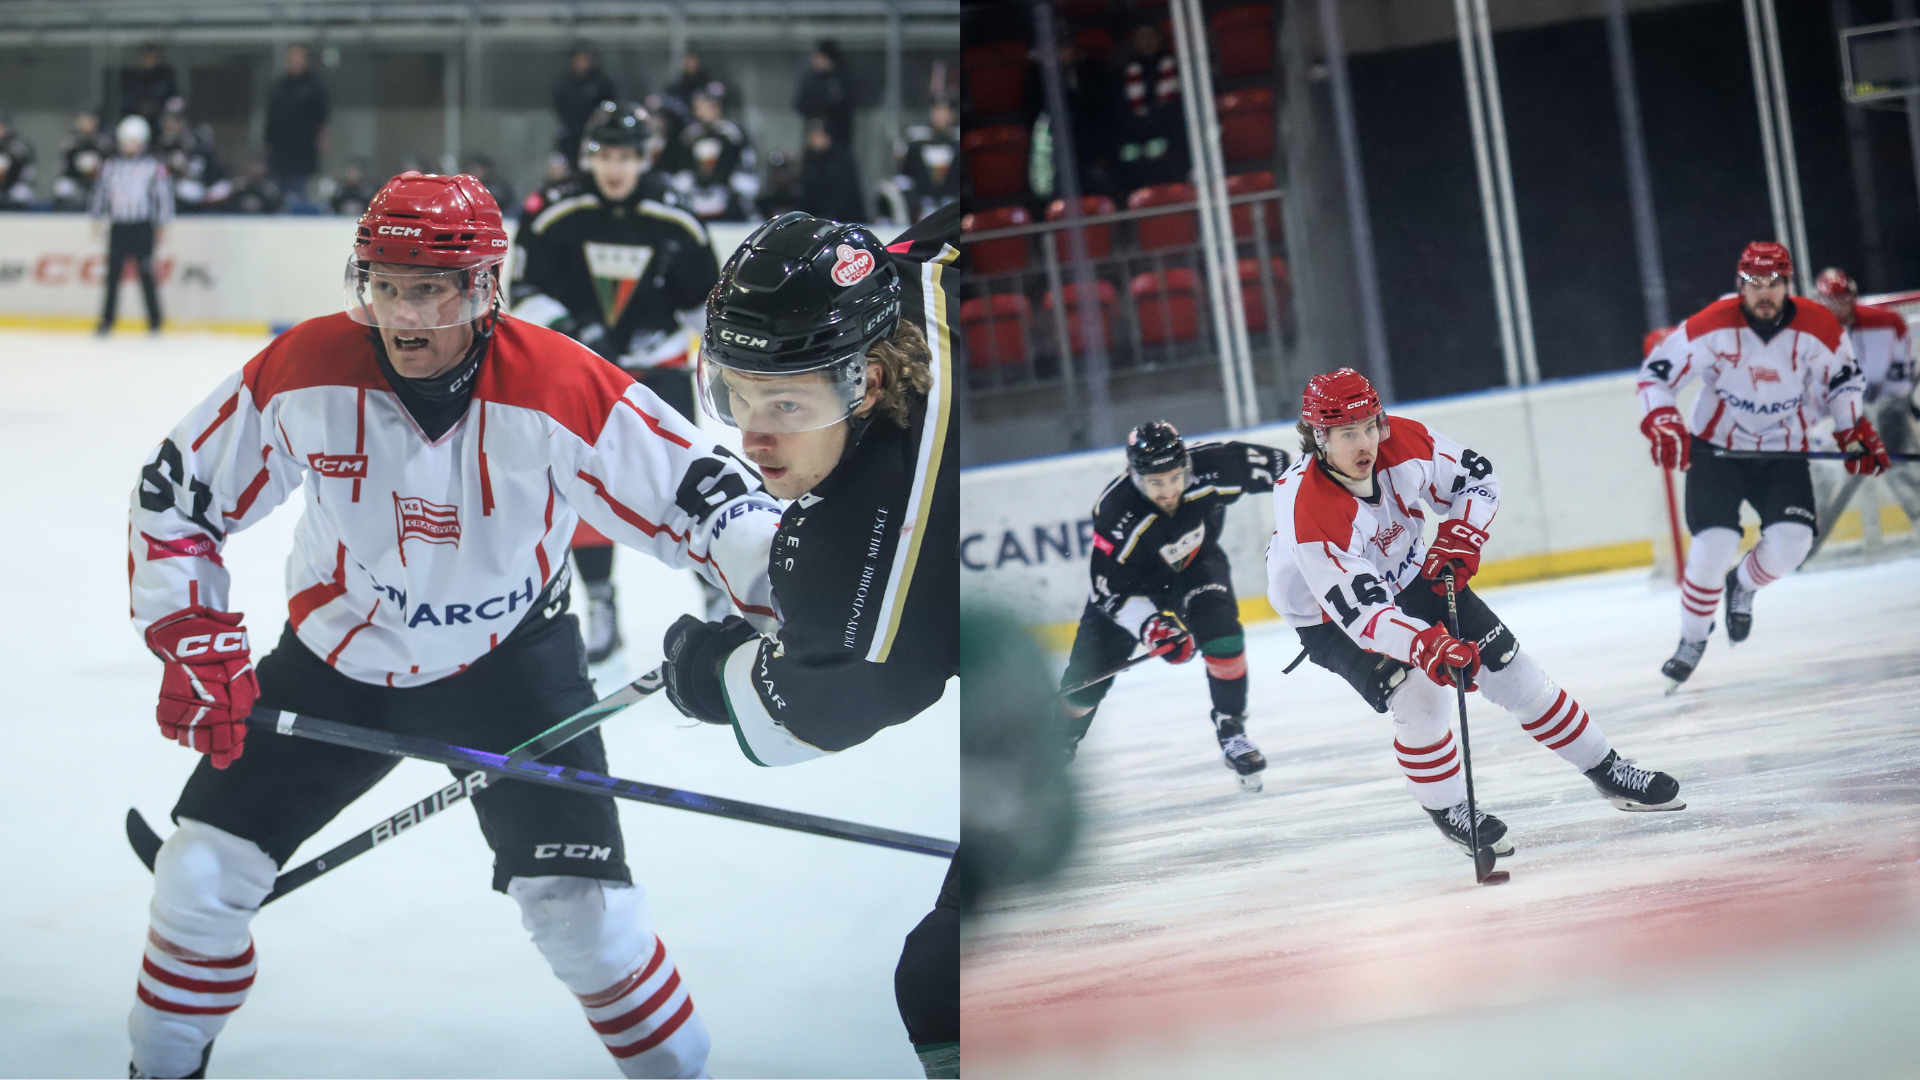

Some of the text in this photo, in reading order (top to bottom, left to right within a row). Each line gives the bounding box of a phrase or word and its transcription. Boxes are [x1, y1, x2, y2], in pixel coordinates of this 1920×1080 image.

[378, 225, 422, 237] CCM
[491, 239, 508, 248] CCM
[867, 303, 894, 332] CCM
[719, 329, 768, 348] CCM
[1347, 399, 1369, 410] CCM
[404, 502, 419, 511] KS
[408, 519, 458, 534] CRACOVIA
[853, 563, 876, 608] DOBRE
[867, 505, 889, 559] MIEJSCE
[1324, 572, 1390, 629] 16
[1446, 580, 1457, 614] CCM
[1477, 622, 1505, 652] CCM
[534, 843, 612, 861] CCM
